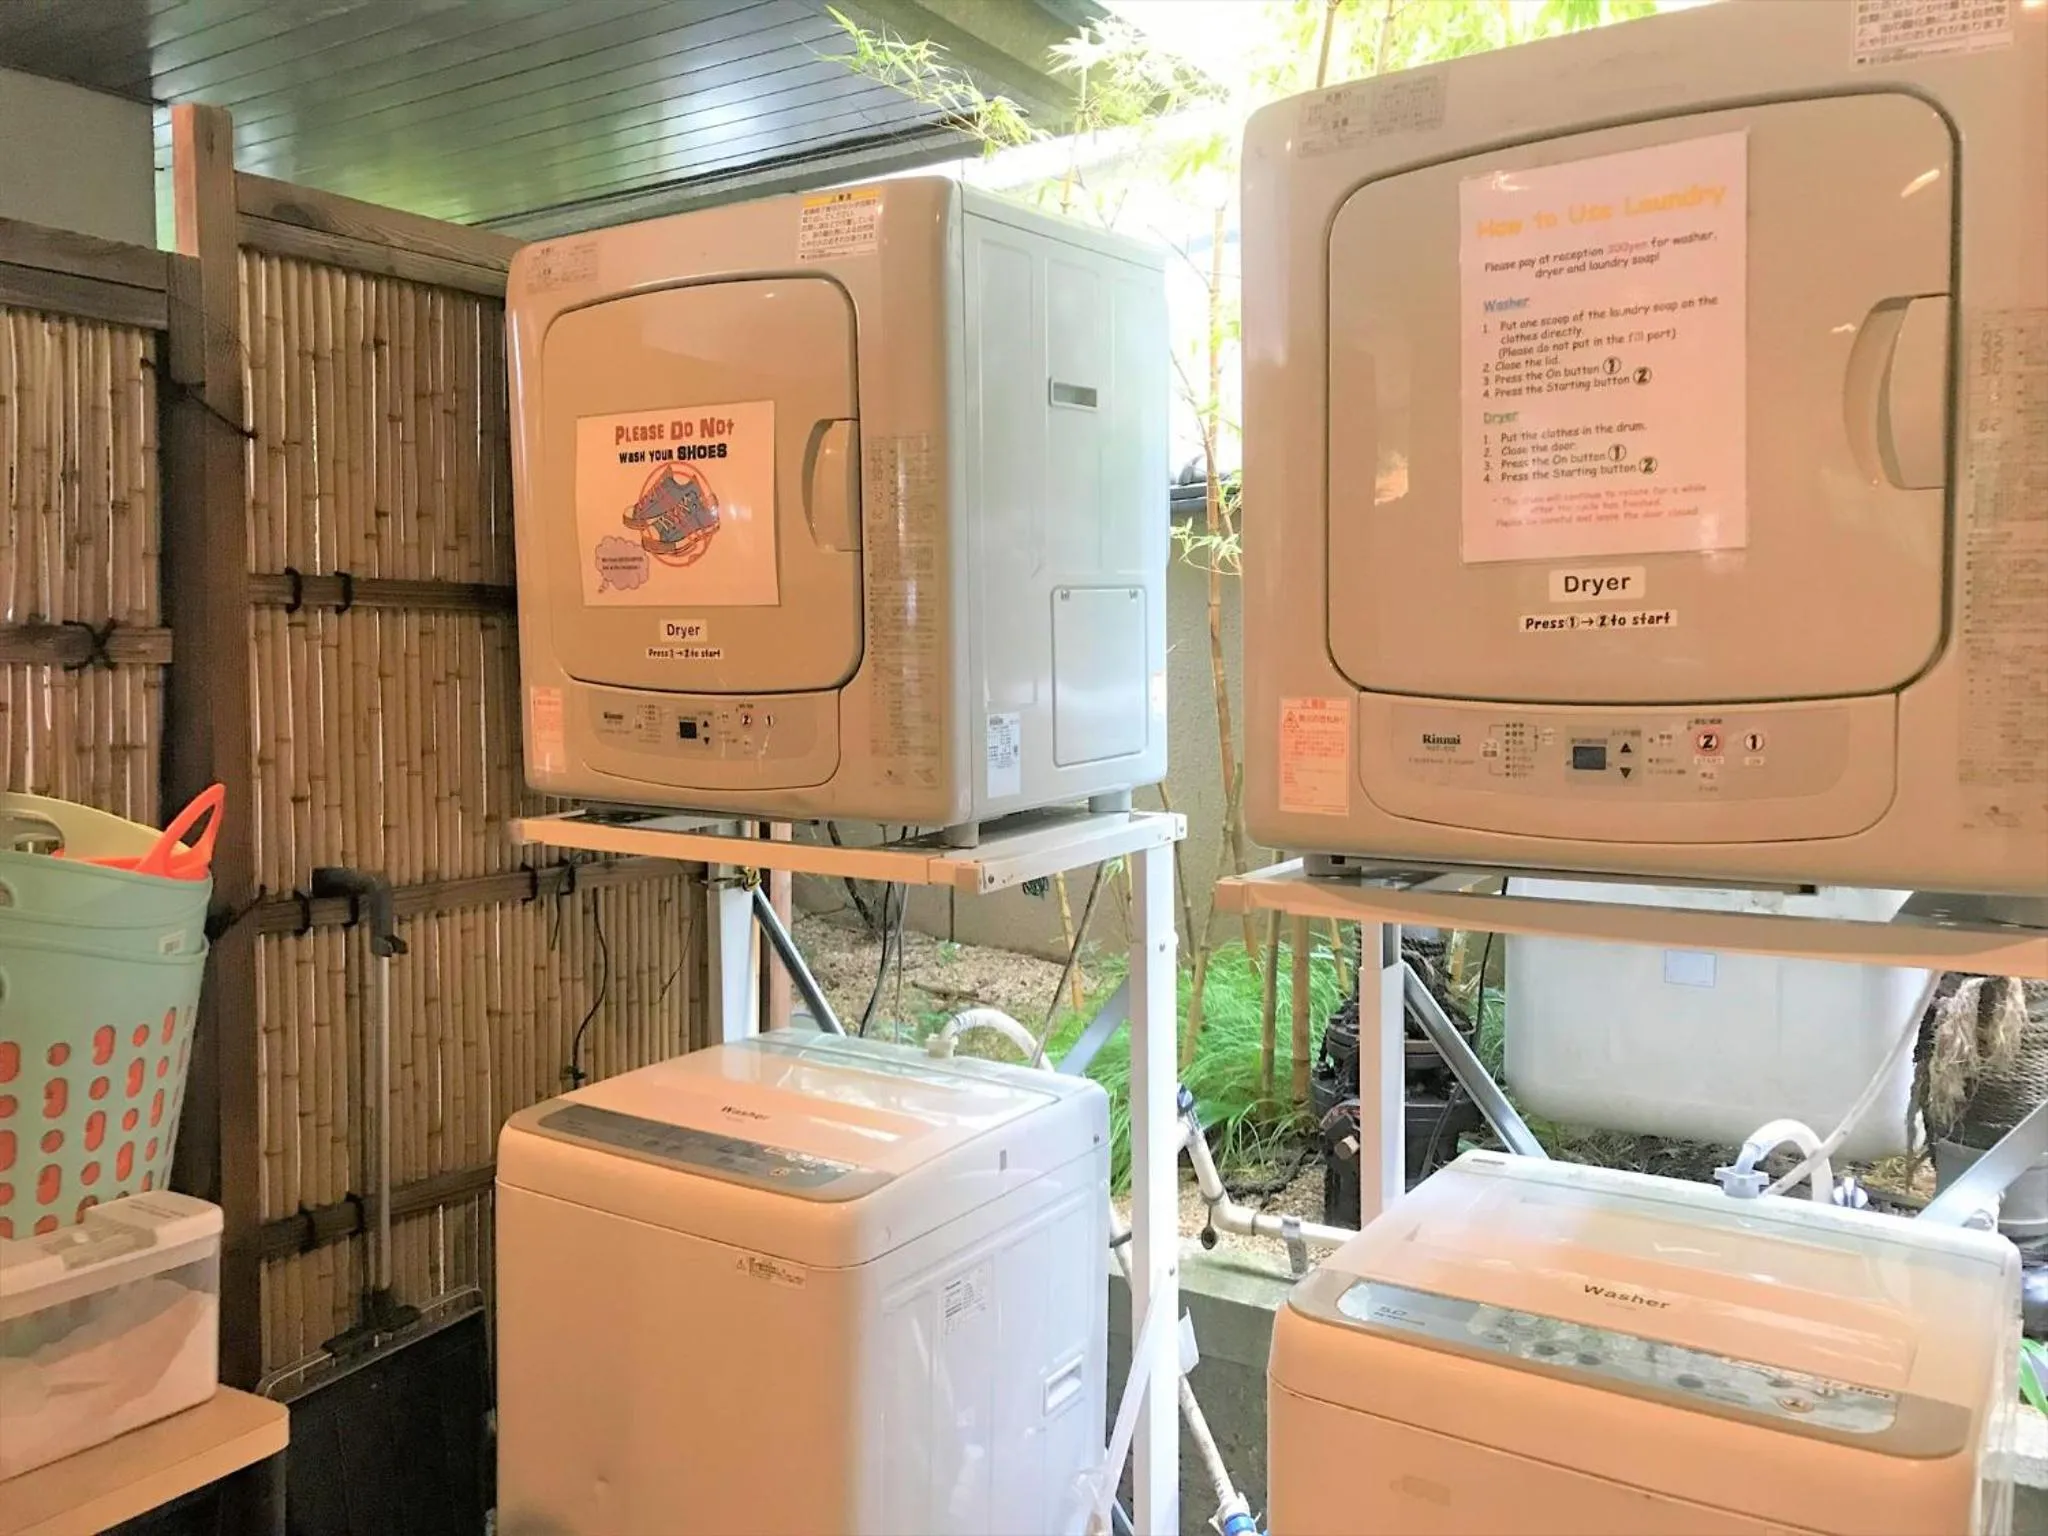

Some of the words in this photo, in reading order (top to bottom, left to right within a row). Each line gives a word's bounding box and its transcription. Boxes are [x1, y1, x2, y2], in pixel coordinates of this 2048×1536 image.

[1477, 219, 1523, 238] How
[1534, 211, 1557, 228] to
[1568, 202, 1612, 224] Use
[1625, 185, 1727, 216] Laundry
[1485, 260, 1516, 273] Please
[1519, 259, 1535, 270] pay
[1539, 254, 1550, 265] at
[1553, 248, 1604, 263] reception
[1651, 236, 1670, 248] for
[1535, 265, 1564, 279] dryer
[1567, 261, 1586, 274] and
[1589, 256, 1628, 273] laundry
[1483, 296, 1530, 313] Washer
[1500, 320, 1517, 332] Put
[1520, 318, 1537, 329] one
[1541, 314, 1570, 327] scoop
[1572, 311, 1585, 322] of
[1588, 309, 1606, 321] the
[1610, 304, 1650, 319] laundry
[1653, 300, 1678, 313] soap
[1681, 299, 1694, 309] on
[1699, 295, 1718, 307] the
[1498, 346, 1534, 360] (Please
[1536, 343, 1550, 354] do
[1552, 341, 1569, 352] not
[1572, 340, 1590, 352] put
[1593, 337, 1603, 347] in
[1606, 334, 1625, 345] the
[1501, 331, 1538, 345] clothes
[1495, 360, 1521, 372] Close
[1525, 358, 1542, 369] the
[1494, 374, 1522, 386] Press
[1525, 371, 1543, 382] the
[1546, 368, 1561, 380] On
[1564, 365, 1599, 378] button
[1494, 387, 1523, 399] Press
[1526, 384, 1544, 395] the
[1546, 379, 1591, 394] Starting
[1594, 375, 1630, 389] button
[1483, 411, 1519, 426] Dryer
[1501, 431, 1518, 443] Put
[1521, 429, 1538, 441] the
[1541, 426, 1580, 440] clothes
[1582, 425, 1593, 435] in
[1596, 423, 1614, 434] the
[677, 442, 728, 461] SHOES
[1501, 444, 1528, 457] Close
[1531, 443, 1549, 453] the
[1501, 457, 1529, 469] Press
[1532, 455, 1550, 467] the
[1552, 453, 1568, 465] On
[1570, 450, 1606, 463] button
[1501, 470, 1529, 482] Press
[1532, 468, 1550, 480] the
[1552, 464, 1597, 479] Starting
[1600, 463, 1637, 476] button
[1652, 485, 1668, 495] for
[1681, 483, 1707, 493] while
[1623, 511, 1639, 520] the
[1564, 575, 1631, 597] Dryer
[1525, 617, 1565, 630] Press
[1610, 613, 1627, 627] to
[1632, 611, 1671, 625] start
[666, 623, 701, 639] Dryer
[648, 648, 668, 658] Press
[691, 648, 699, 658] to
[701, 648, 721, 658] start
[1422, 733, 1461, 745] Rinnai
[719, 1104, 770, 1120] Washer
[1584, 1283, 1671, 1309] Washer
